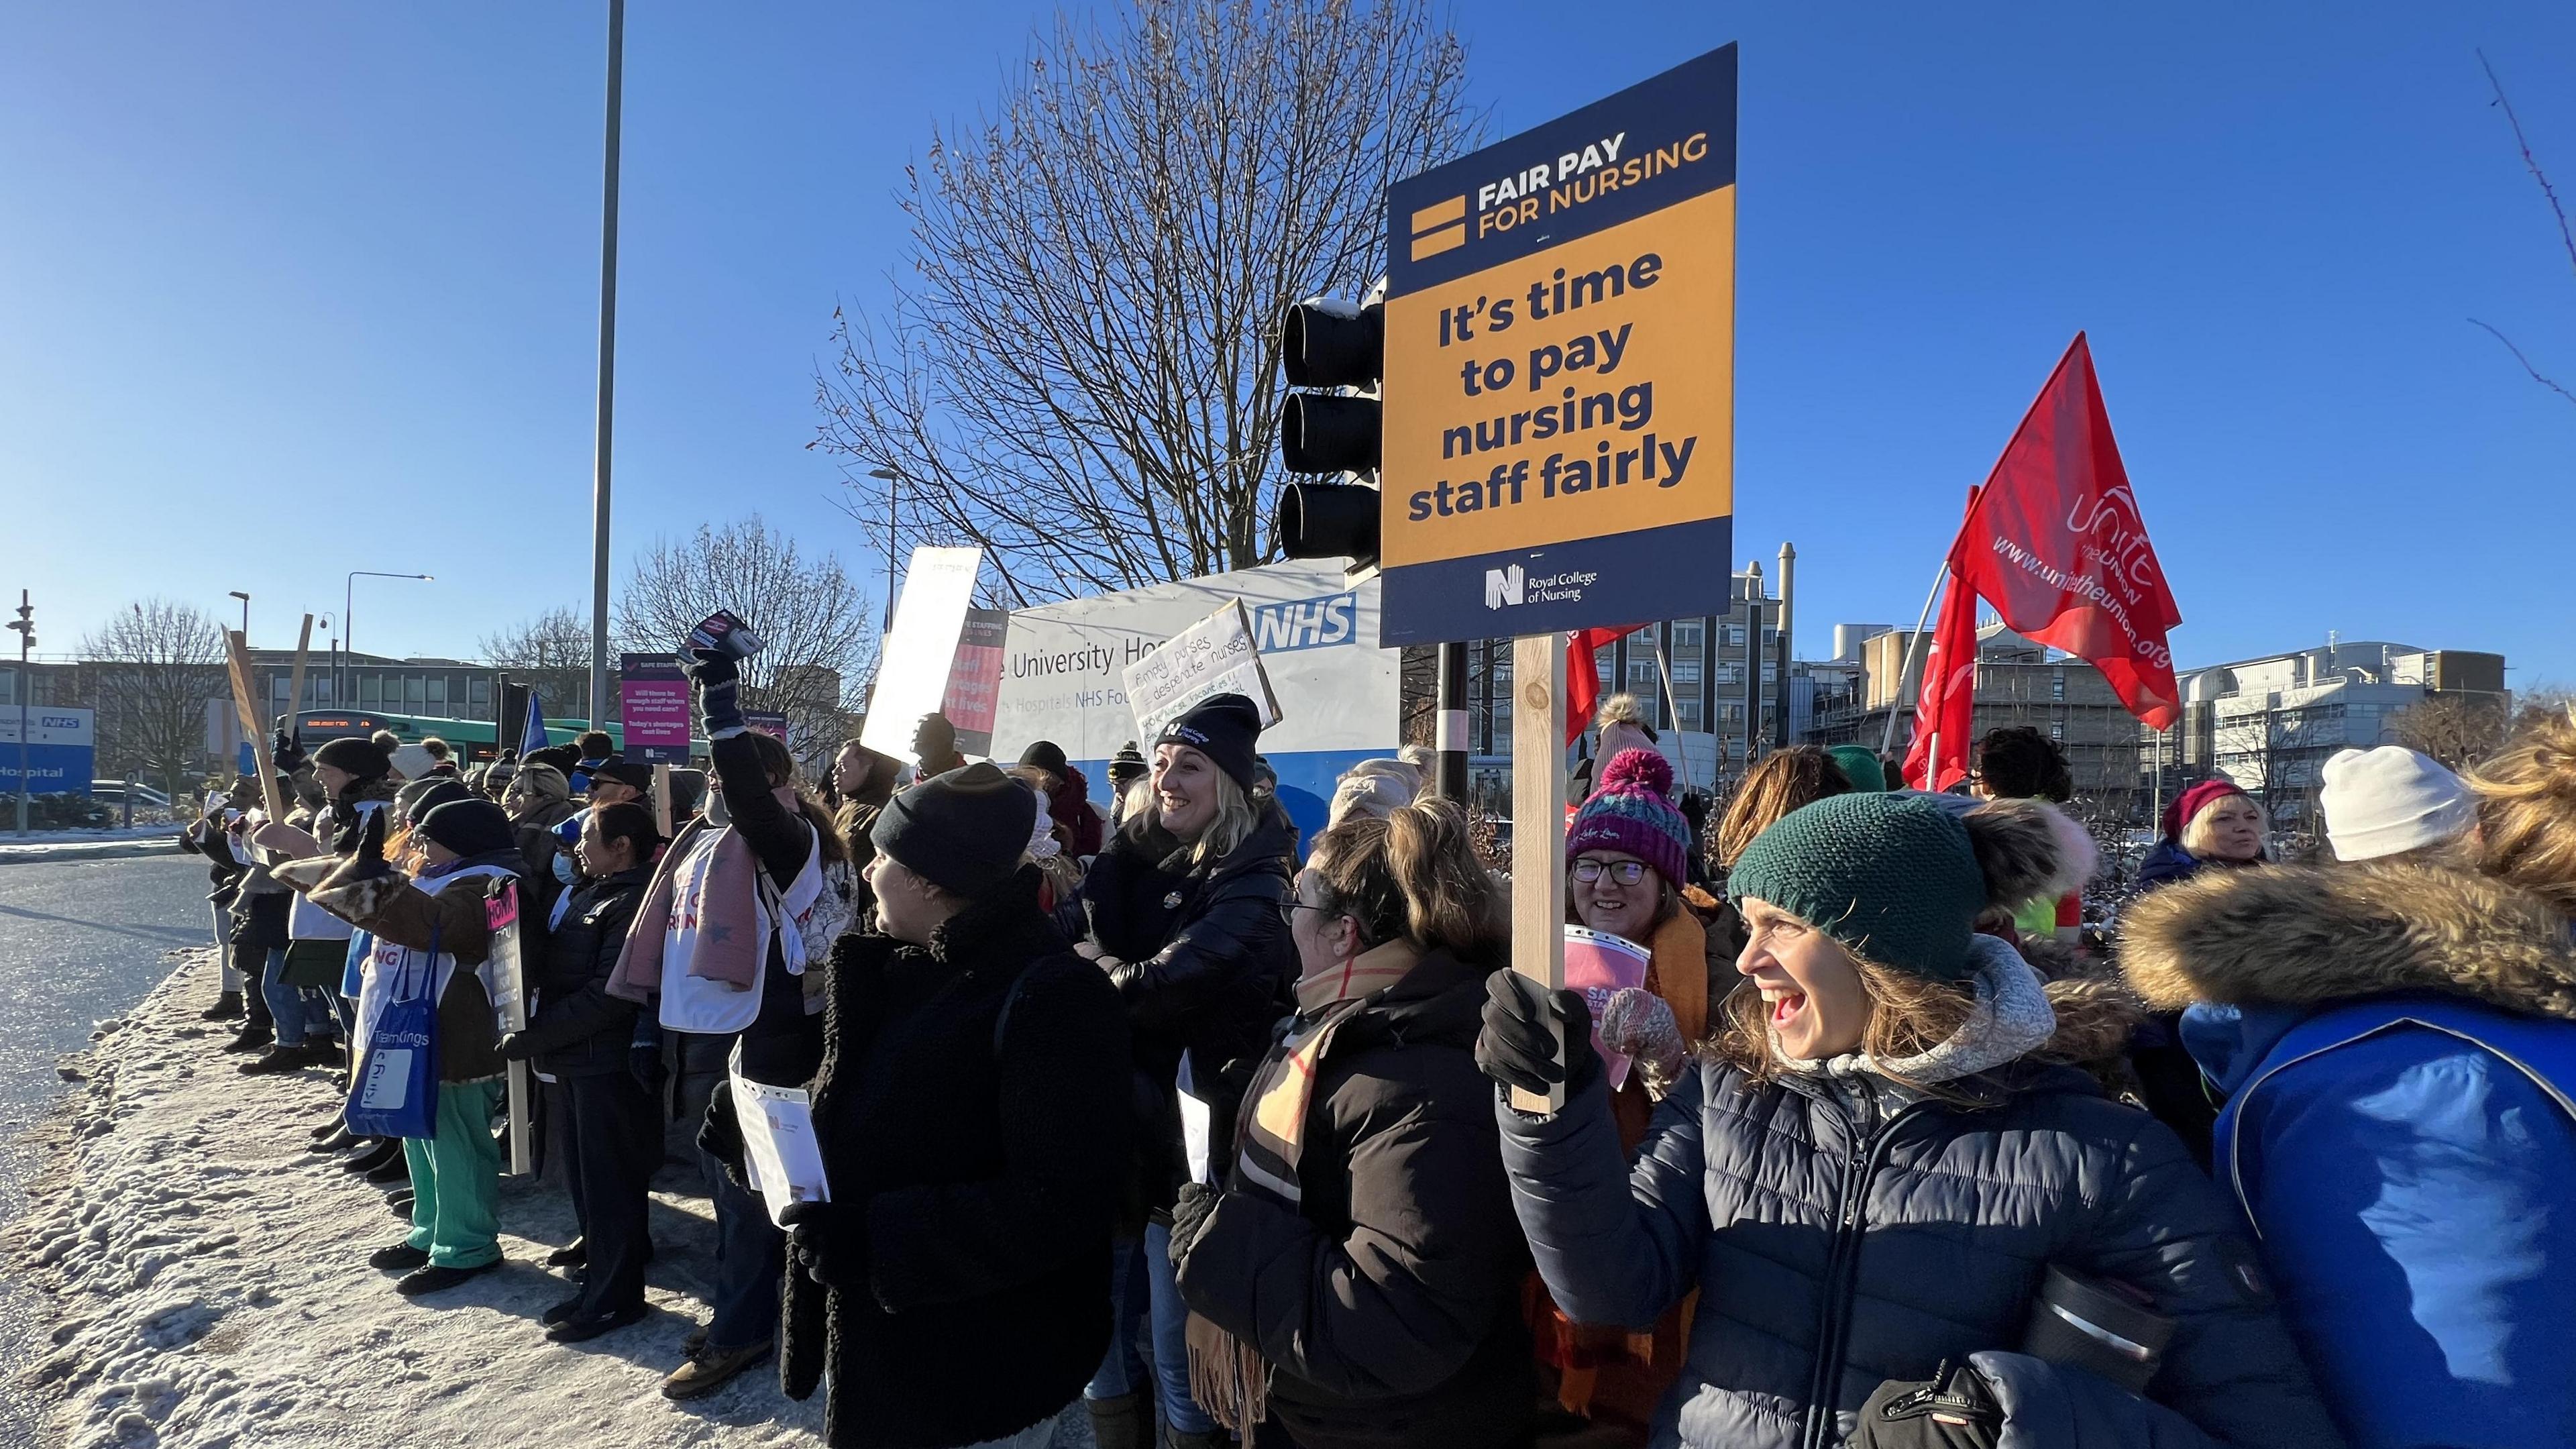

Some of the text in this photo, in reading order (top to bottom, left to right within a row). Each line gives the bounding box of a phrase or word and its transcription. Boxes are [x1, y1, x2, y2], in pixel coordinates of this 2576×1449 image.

[1478, 131, 1625, 212] FAIR PAY
[1478, 133, 1708, 239] FOR NURSING
[1439, 253, 1662, 347] It's time
[1461, 322, 1633, 397] to pay
[1442, 381, 1652, 460] nursing
[1408, 433, 1697, 521] staff fairly
[1528, 588, 1581, 604] of Nursing
[1529, 571, 1597, 592] Royal College
[1992, 536, 2171, 669] www.unitetheunion.org
[972, 622, 1003, 630] STAFFING
[1256, 596, 1353, 651] NHS
[1014, 642, 1114, 678] University
[1135, 636, 1212, 686] Empty purses
[1153, 660, 1205, 701] desperate
[1210, 635, 1247, 663] nurses
[43, 718, 78, 727] NHS
[959, 697, 987, 713] lives
[1075, 690, 1102, 709] NHS
